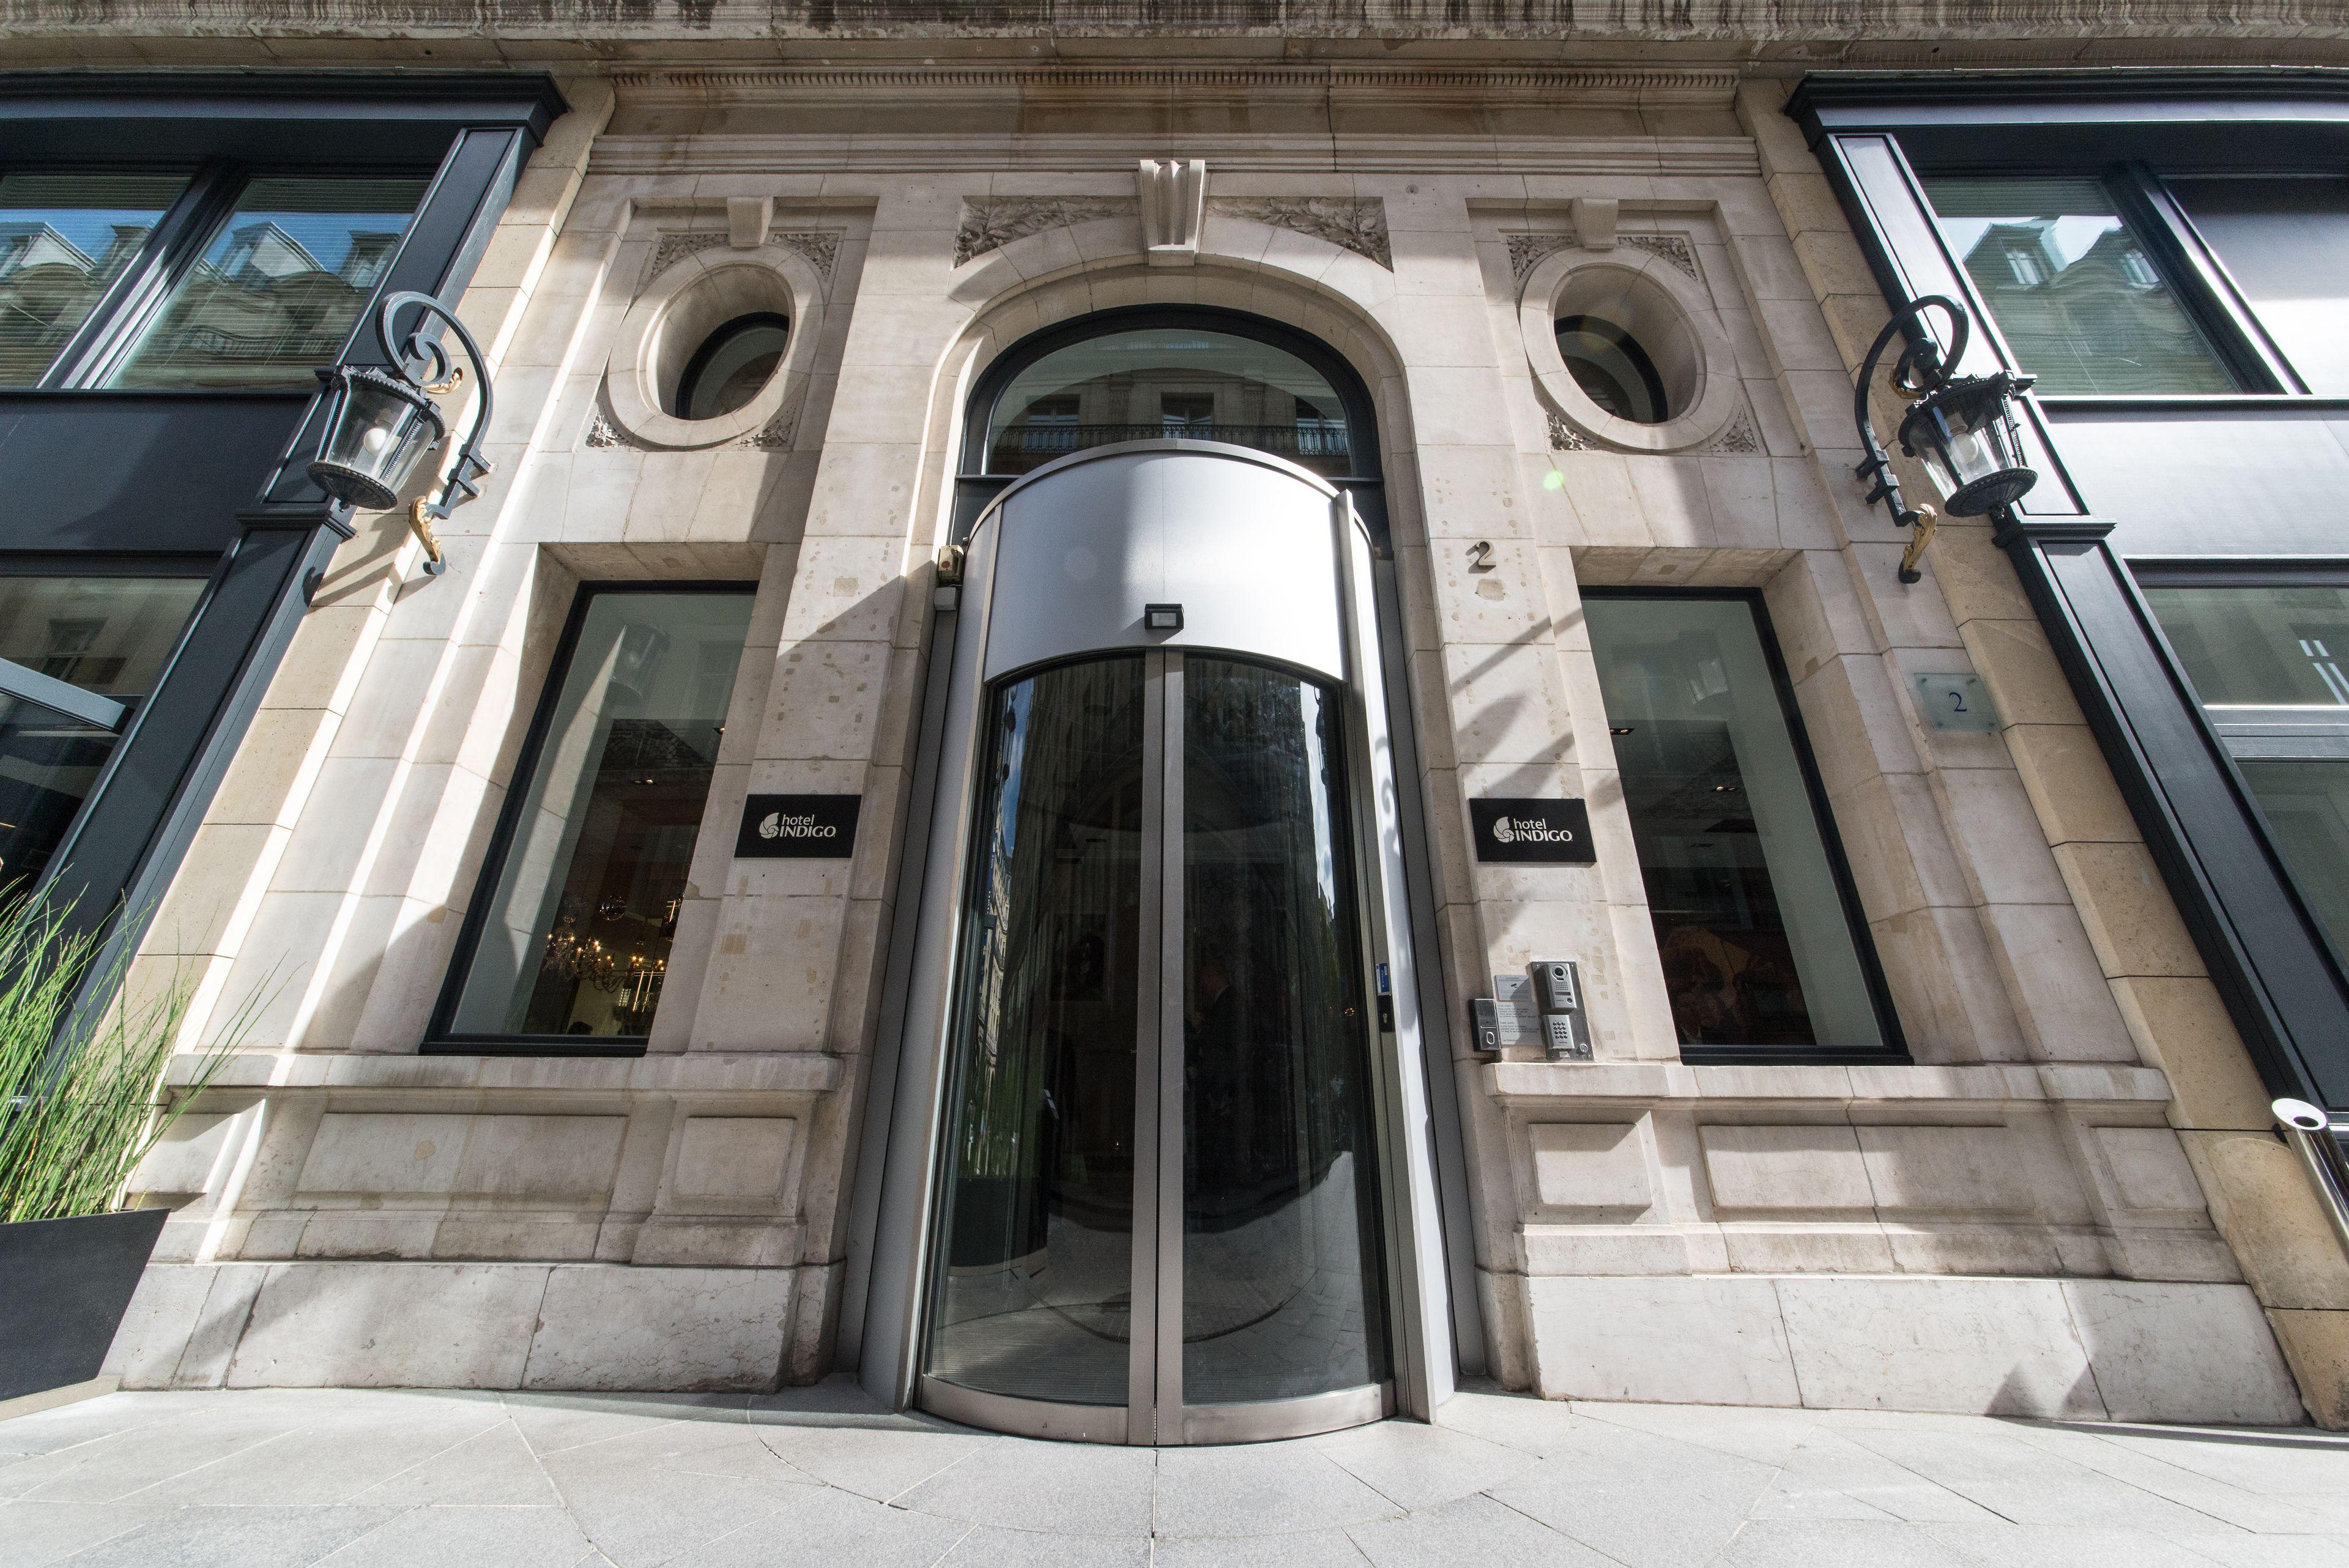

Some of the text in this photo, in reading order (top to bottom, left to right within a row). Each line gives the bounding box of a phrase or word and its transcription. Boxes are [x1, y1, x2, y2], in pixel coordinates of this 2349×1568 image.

[1475, 540, 1497, 568] 2
[1948, 691, 1967, 712] 2
[782, 814, 815, 826] hotel
[1513, 818, 1547, 830] hotel
[779, 826, 836, 838] INDIGO
[1515, 830, 1573, 842] INDIGO
